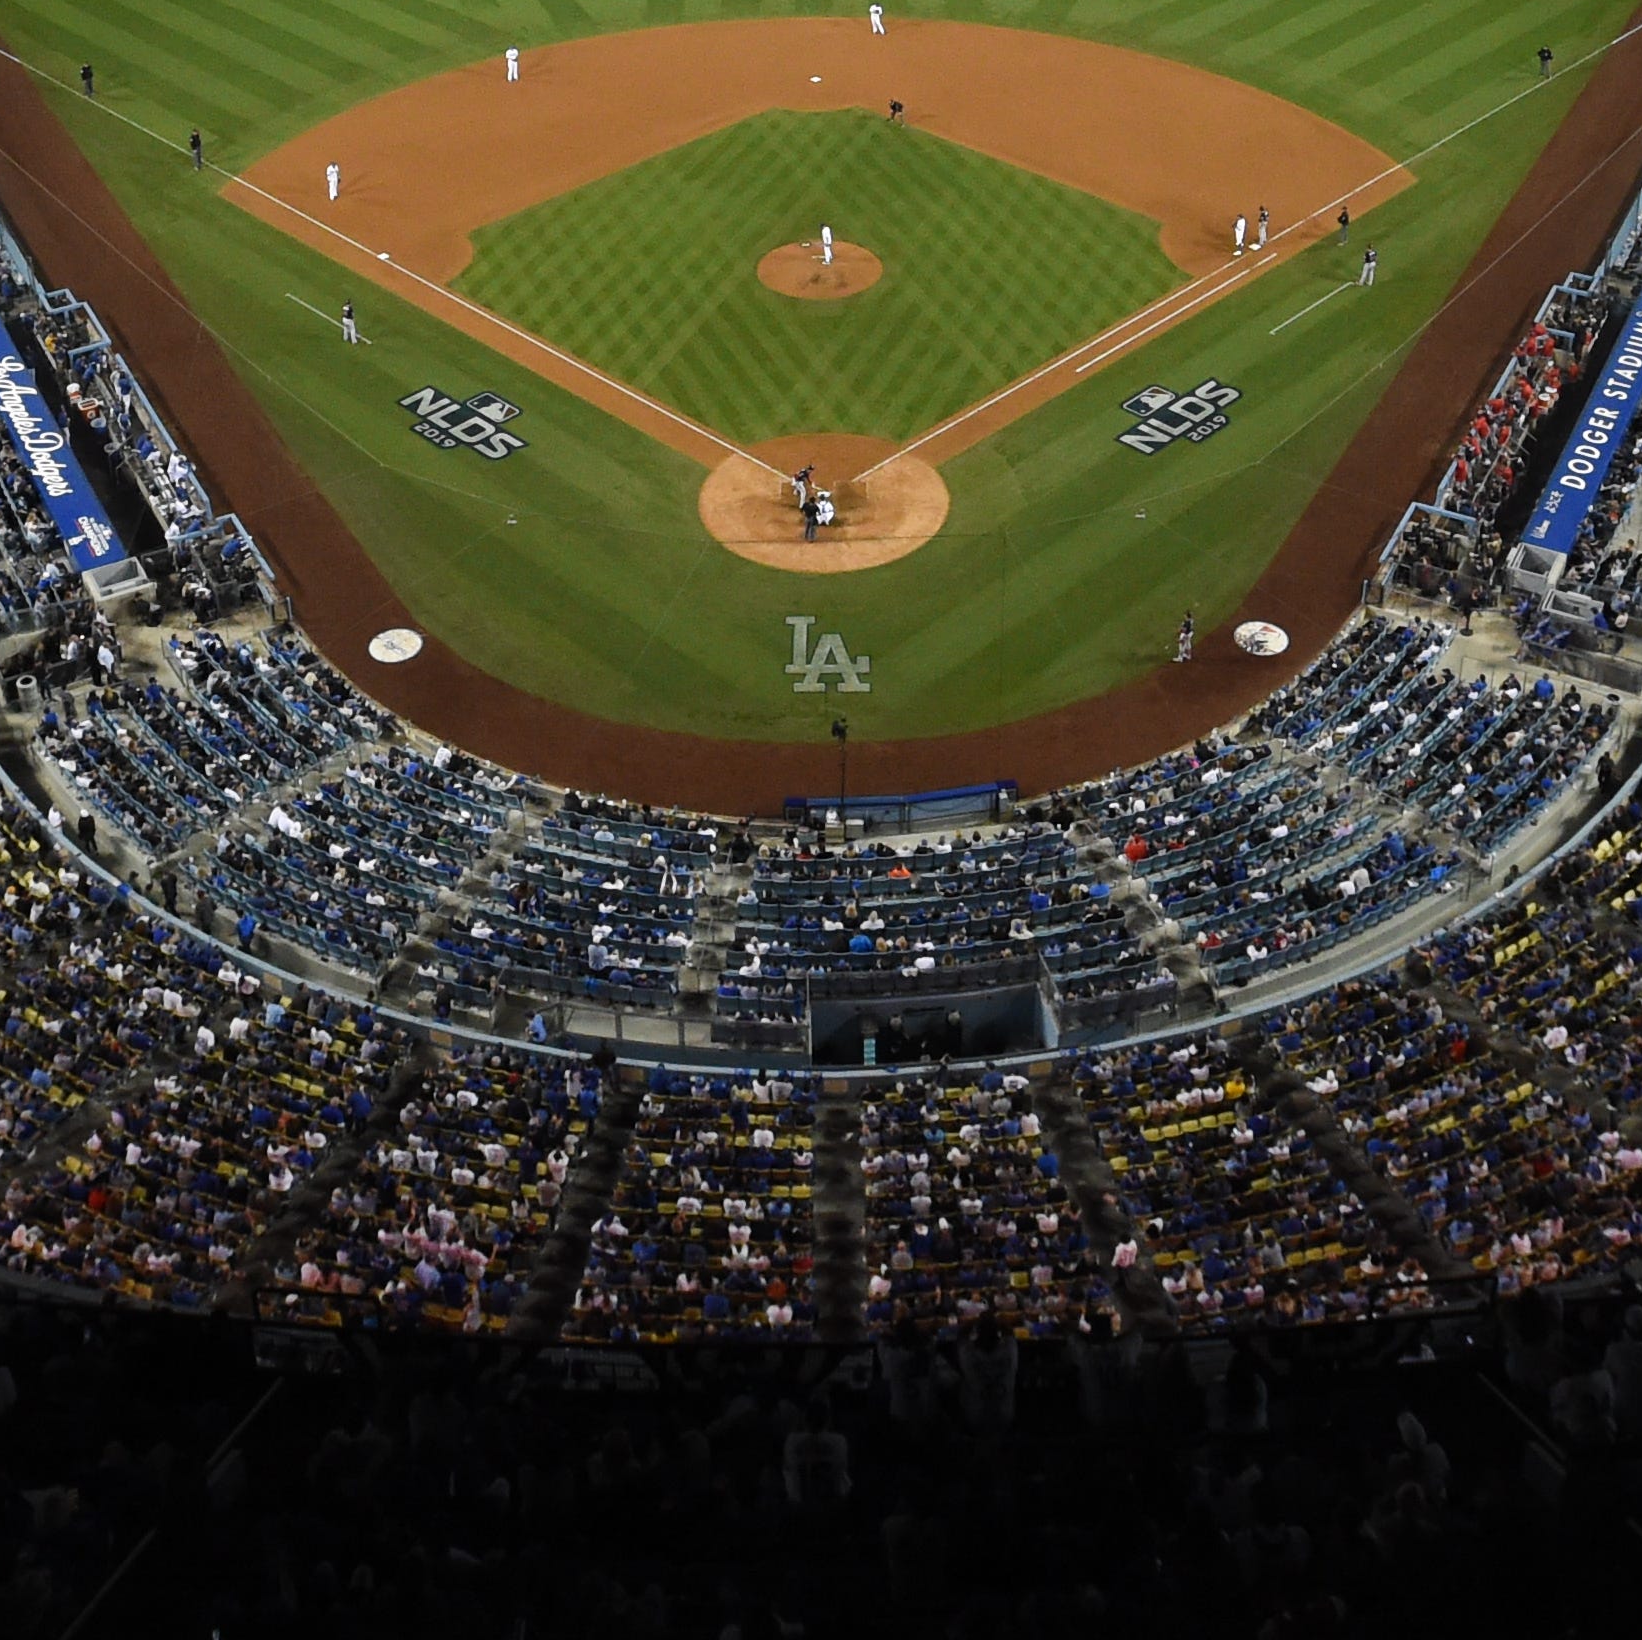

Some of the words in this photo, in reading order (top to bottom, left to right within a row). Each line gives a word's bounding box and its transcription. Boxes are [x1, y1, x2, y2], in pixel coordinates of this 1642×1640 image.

[400, 387, 525, 459] NLDS
[413, 422, 458, 448] 2019
[1119, 379, 1241, 455] NLDS
[1187, 415, 1227, 442] 2019
[1560, 407, 1620, 490] DODGER
[20, 431, 74, 496] Dodgers
[784, 616, 872, 693] LA
